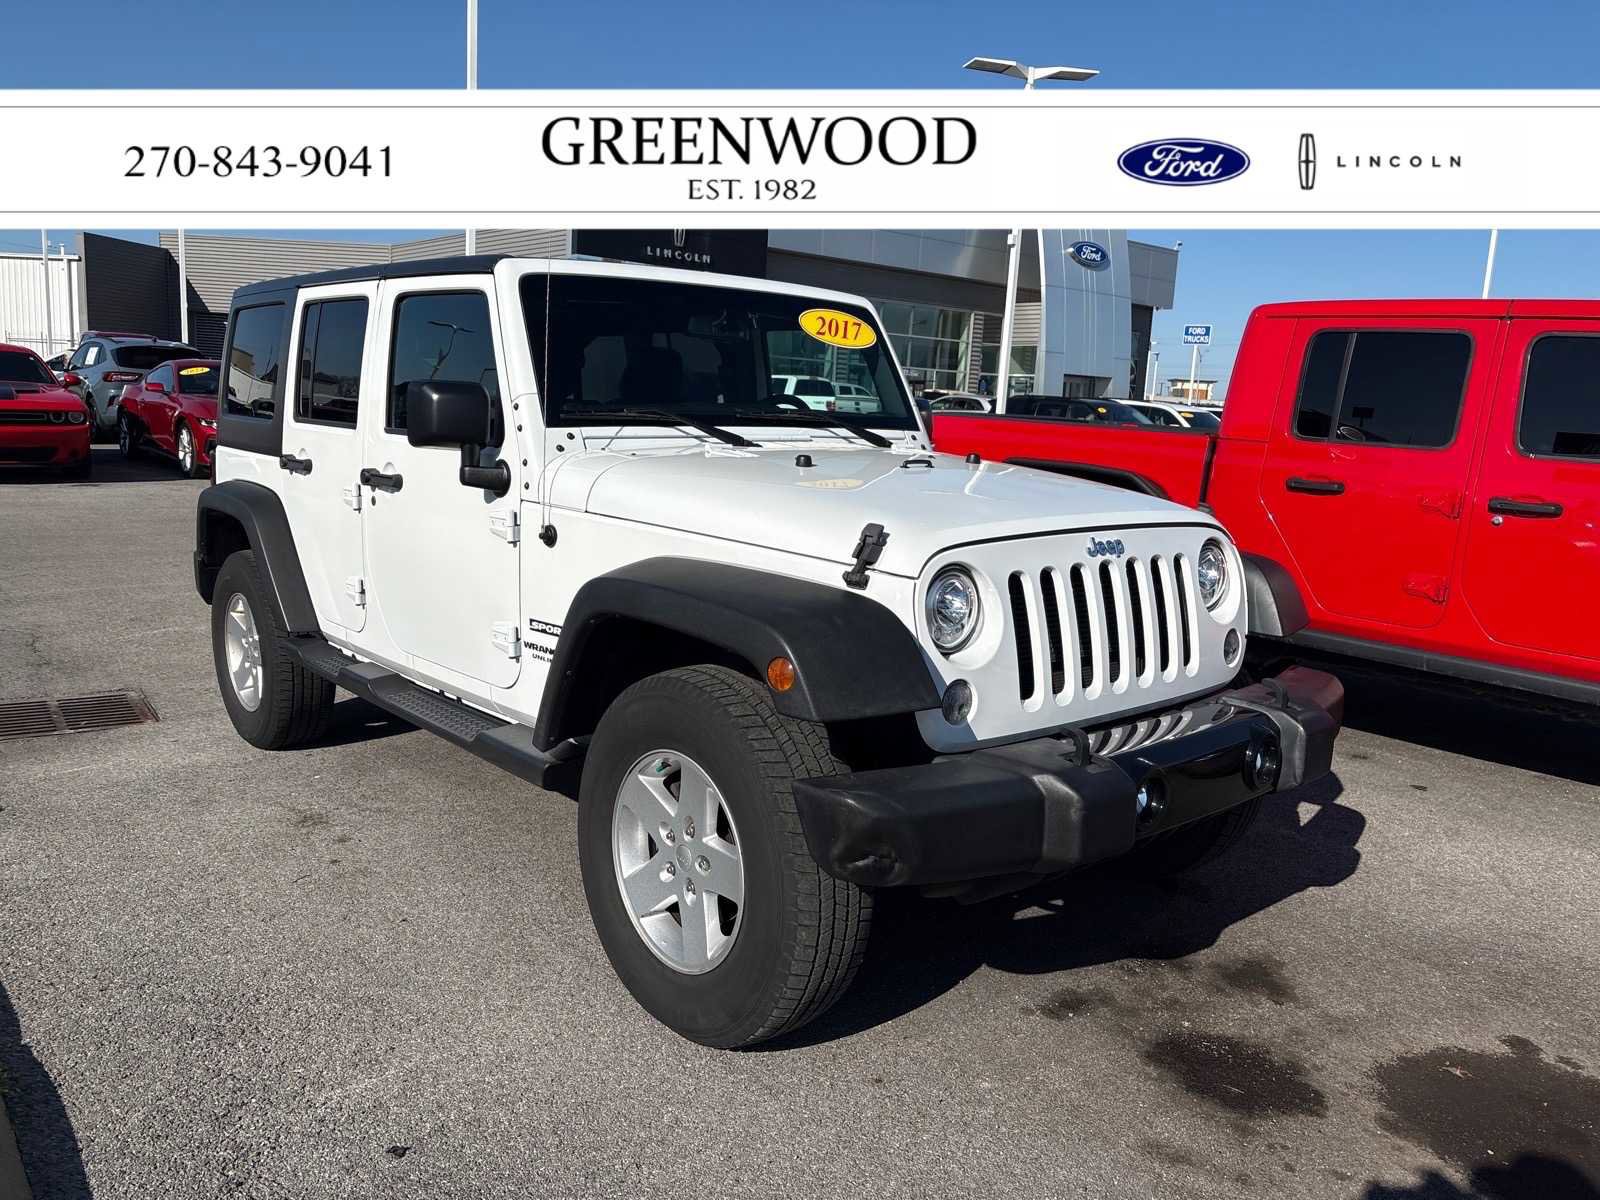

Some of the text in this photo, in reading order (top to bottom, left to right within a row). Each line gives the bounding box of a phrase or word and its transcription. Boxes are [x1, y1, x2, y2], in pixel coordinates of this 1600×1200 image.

[646, 246, 711, 264] LINCOLN
[1080, 245, 1101, 261] Ford
[815, 316, 862, 340] 2017
[1188, 327, 1206, 335] FORD
[1184, 335, 1209, 343] TRUCKS
[1087, 537, 1125, 558] Jeep
[530, 621, 562, 635] SPOR
[523, 641, 555, 655] WRAN
